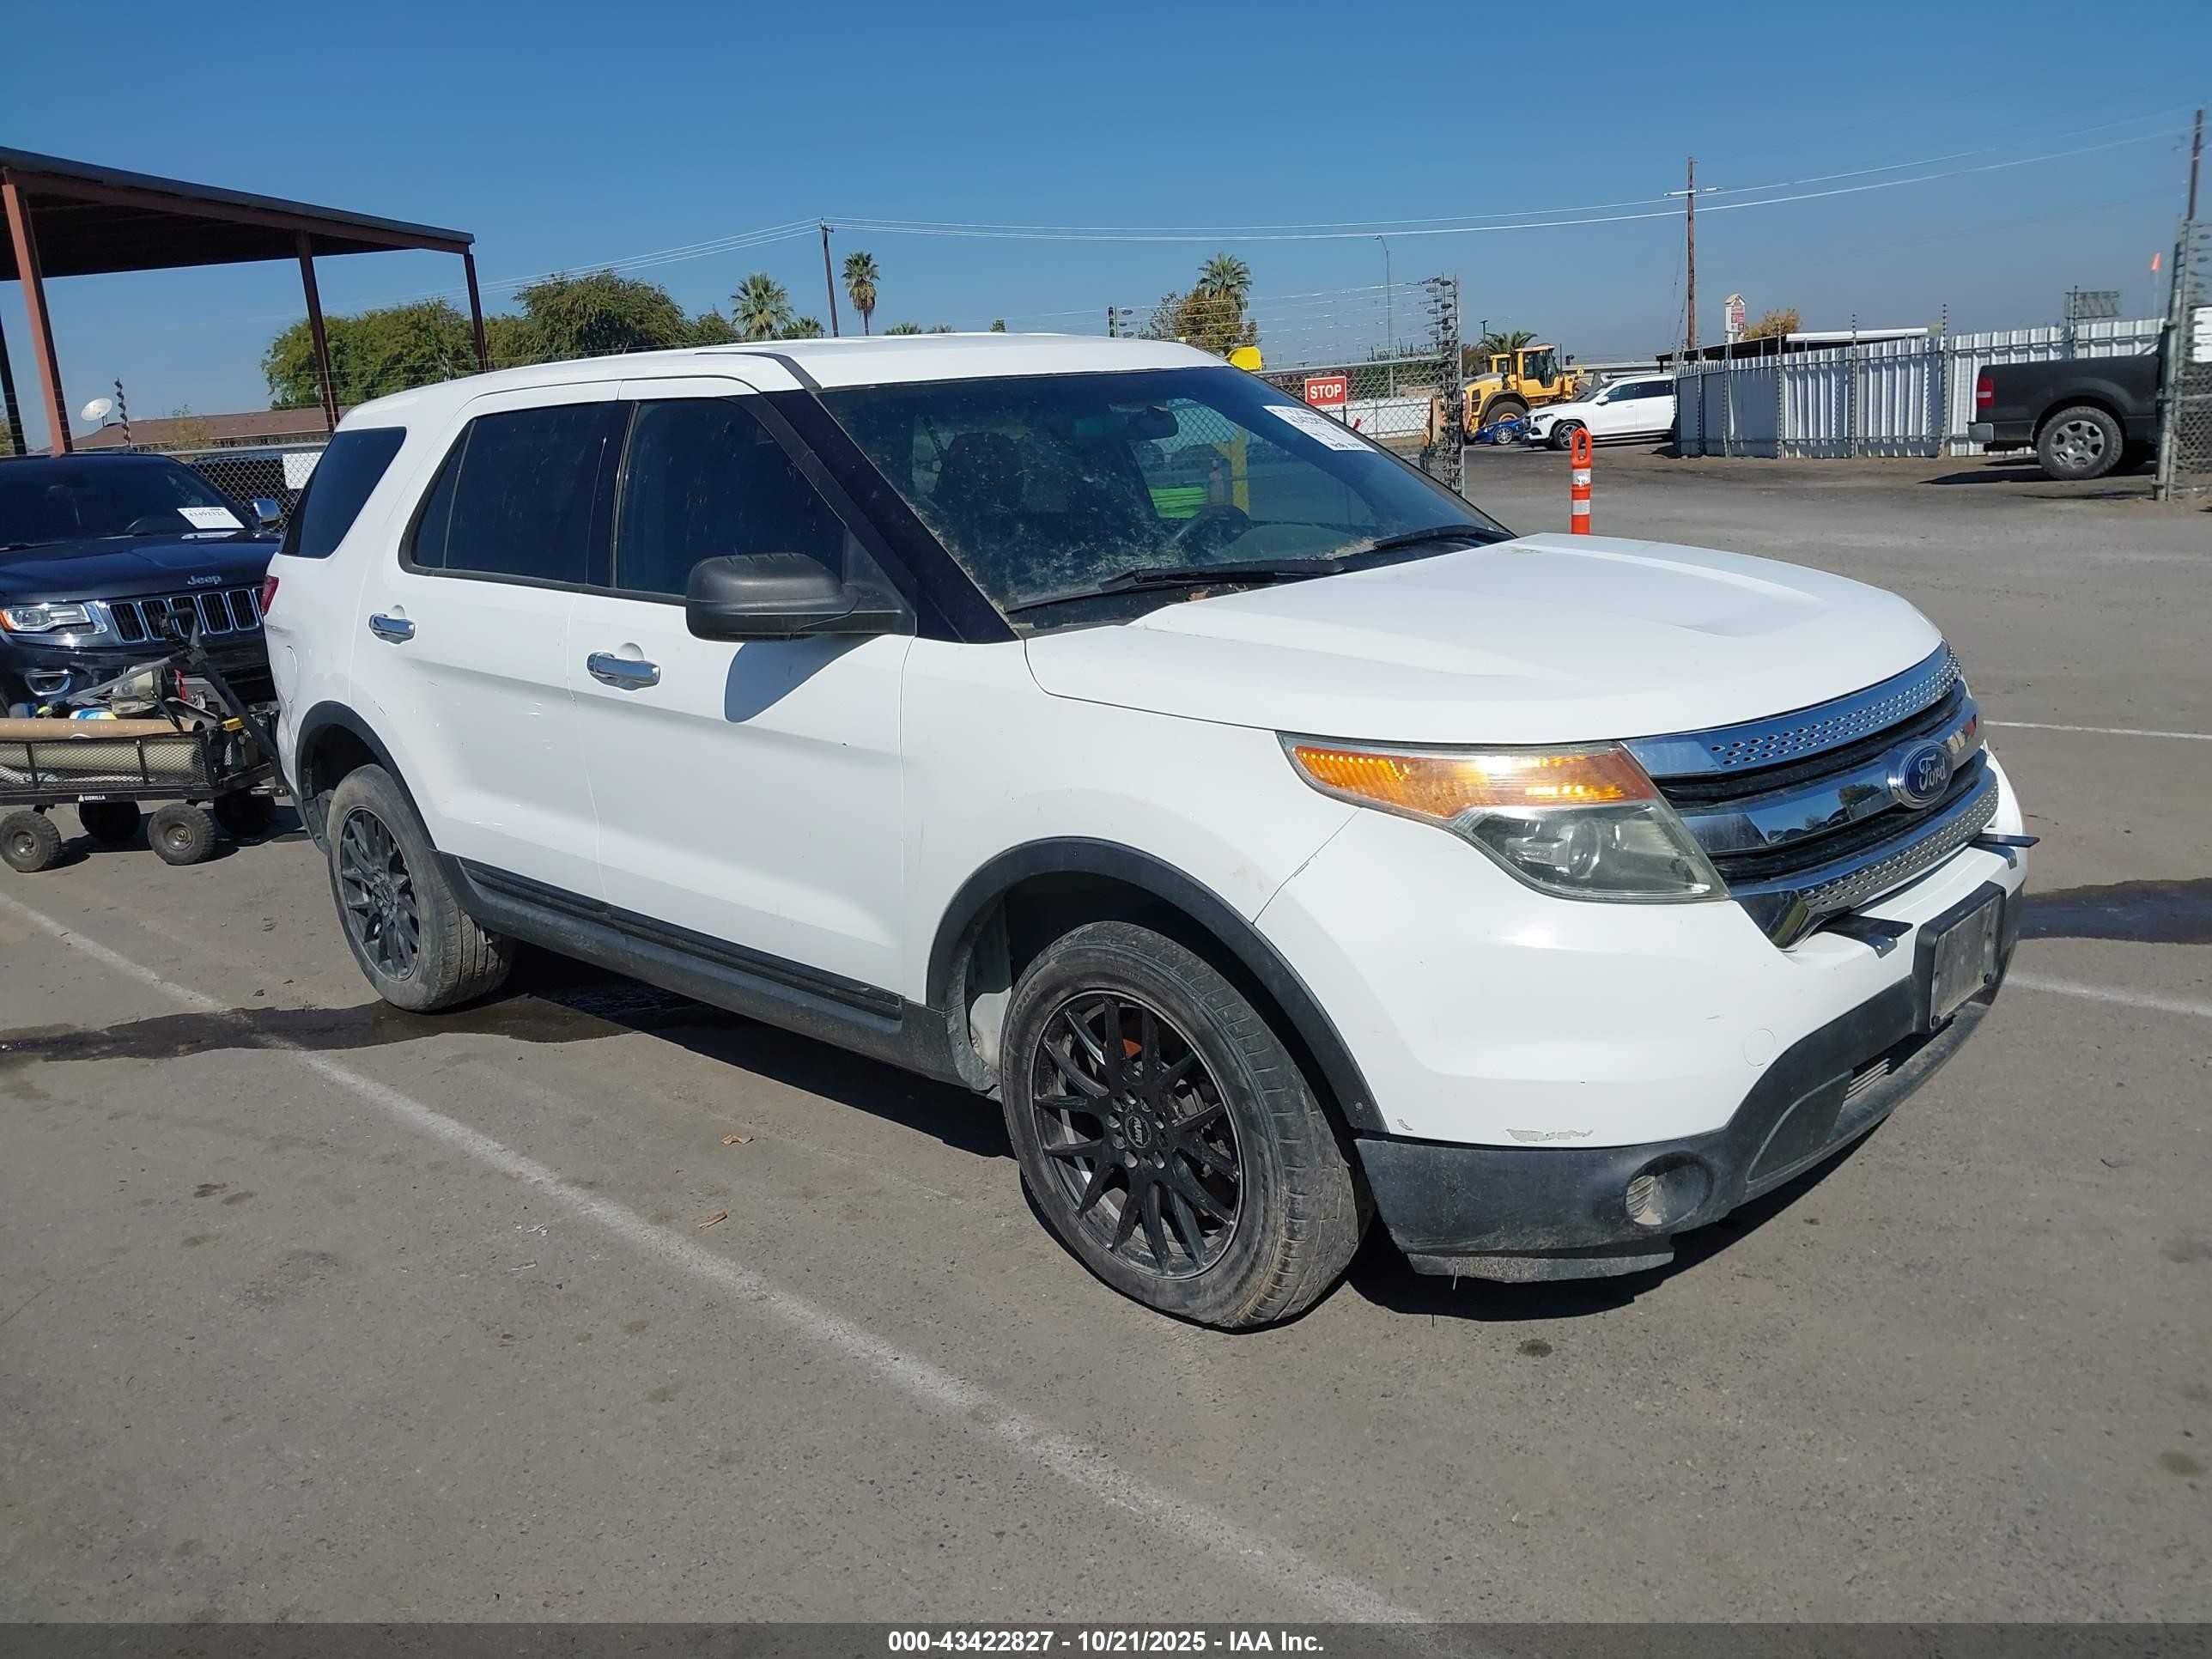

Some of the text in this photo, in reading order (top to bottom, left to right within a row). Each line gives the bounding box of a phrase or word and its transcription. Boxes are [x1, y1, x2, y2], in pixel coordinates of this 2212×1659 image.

[1310, 384, 1342, 399] STOP
[186, 574, 222, 586] Jeep
[1917, 753, 1947, 792] Ford
